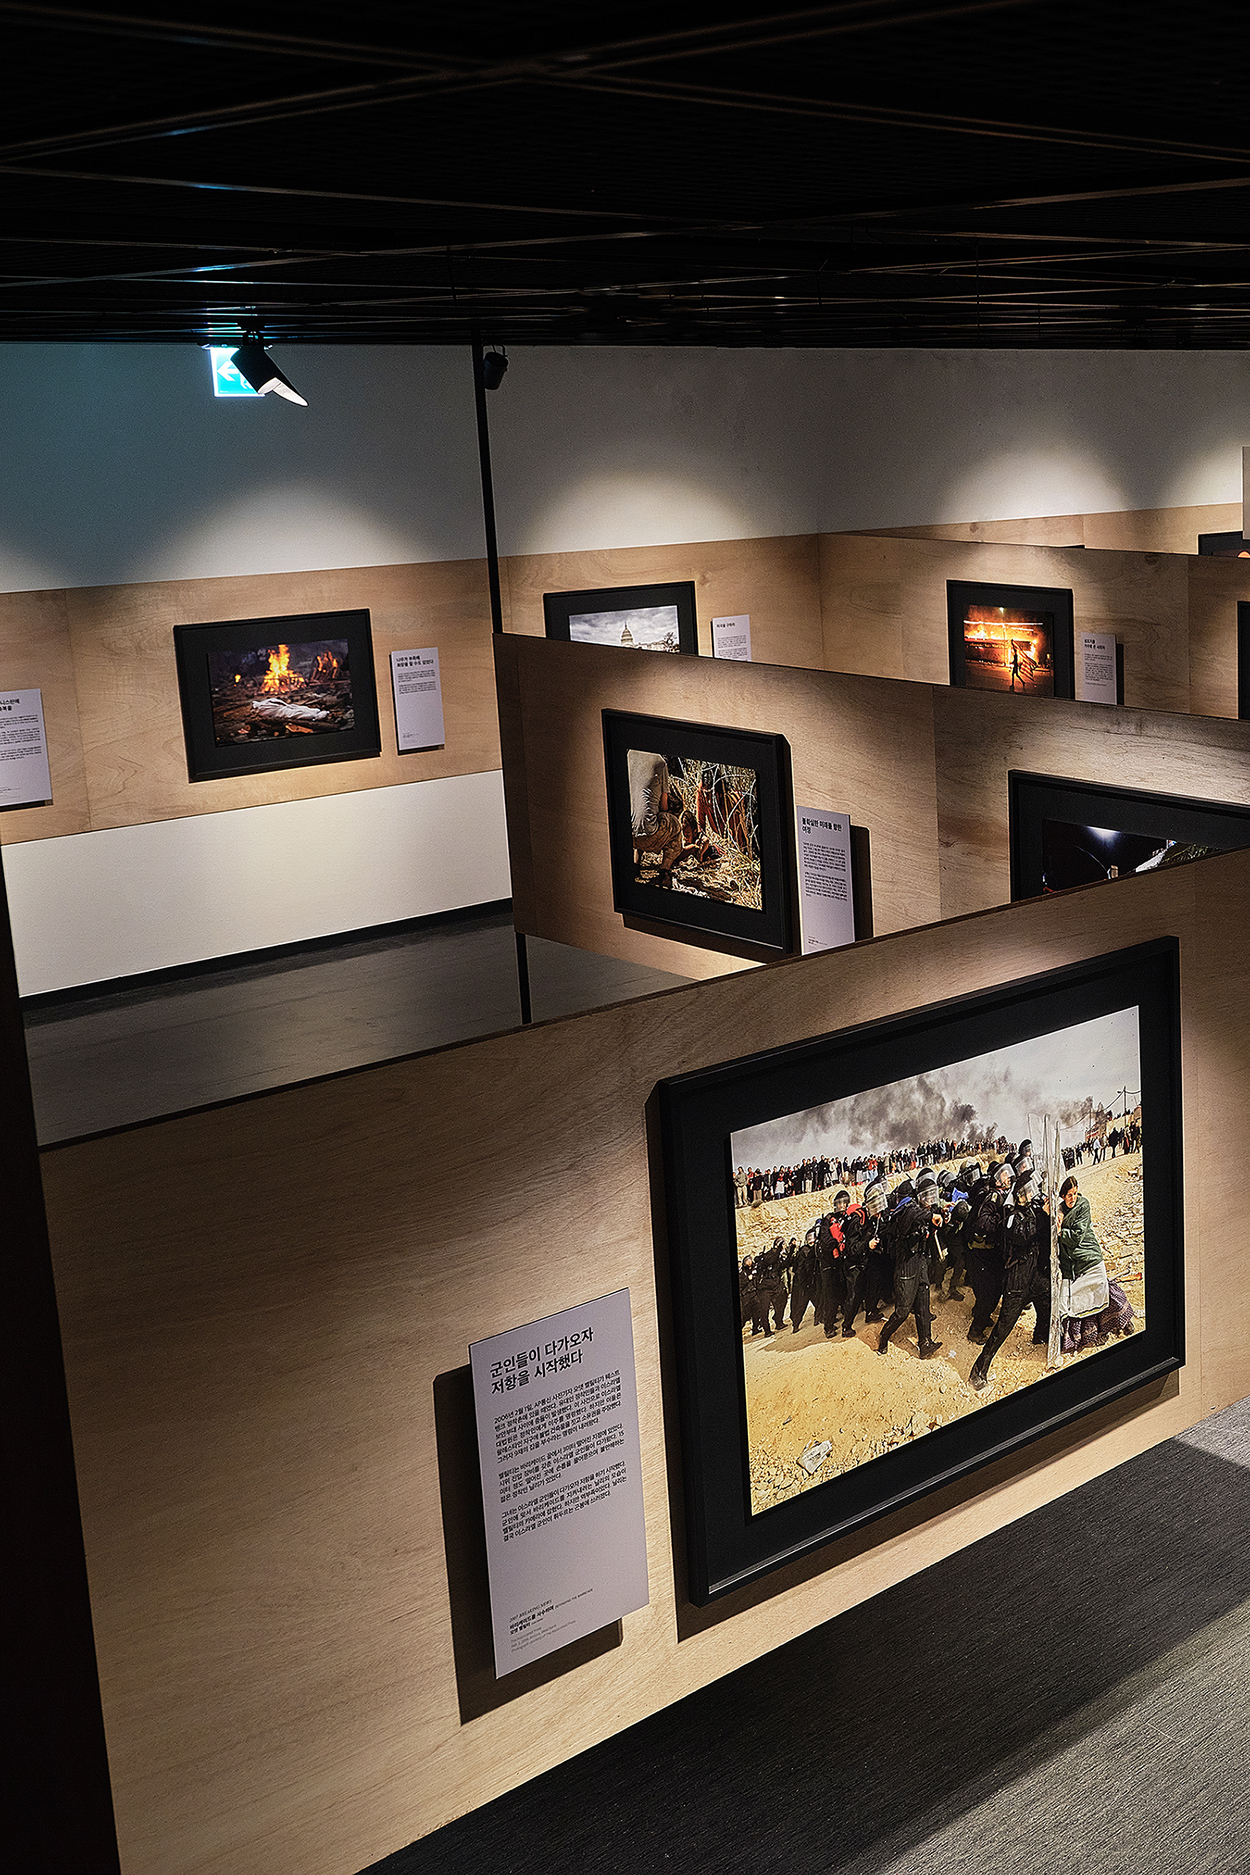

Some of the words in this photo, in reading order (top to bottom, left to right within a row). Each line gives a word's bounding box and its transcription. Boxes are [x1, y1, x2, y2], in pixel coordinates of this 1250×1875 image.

[489, 1346, 540, 1378] 군인들이
[545, 1326, 593, 1358] 다가오자
[490, 1368, 530, 1396] 저항을
[533, 1348, 583, 1380] 시작했다
